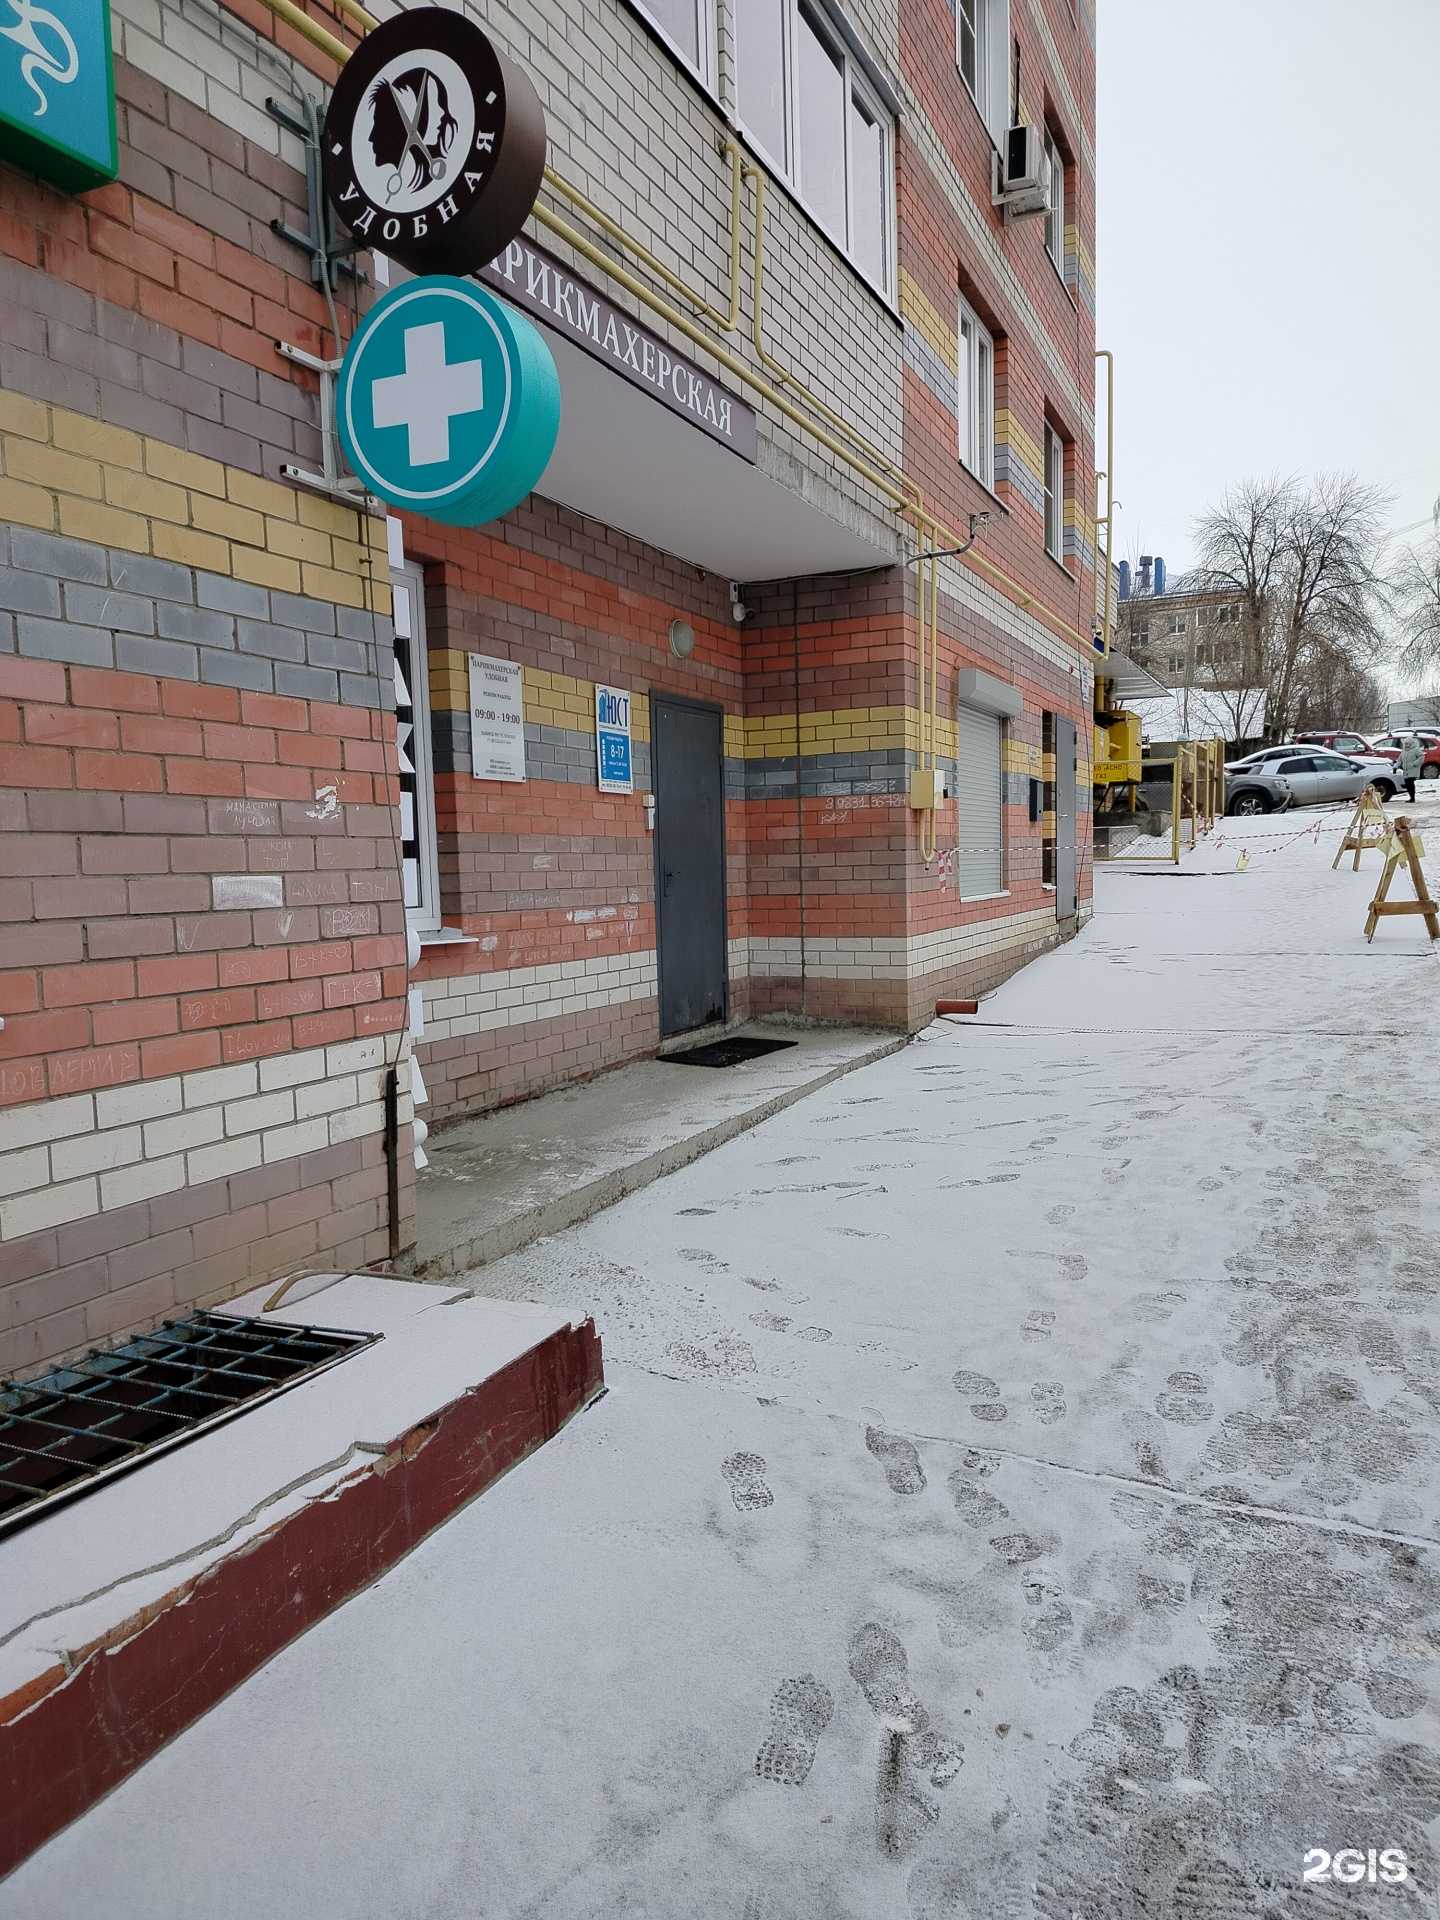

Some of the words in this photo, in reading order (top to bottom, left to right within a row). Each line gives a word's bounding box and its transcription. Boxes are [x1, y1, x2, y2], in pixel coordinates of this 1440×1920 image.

[340, 130, 495, 241] УДОБНАЯ
[475, 708, 496, 721] 09:00
[502, 712, 520, 724] 19:00
[610, 744, 624, 759] 8-17
